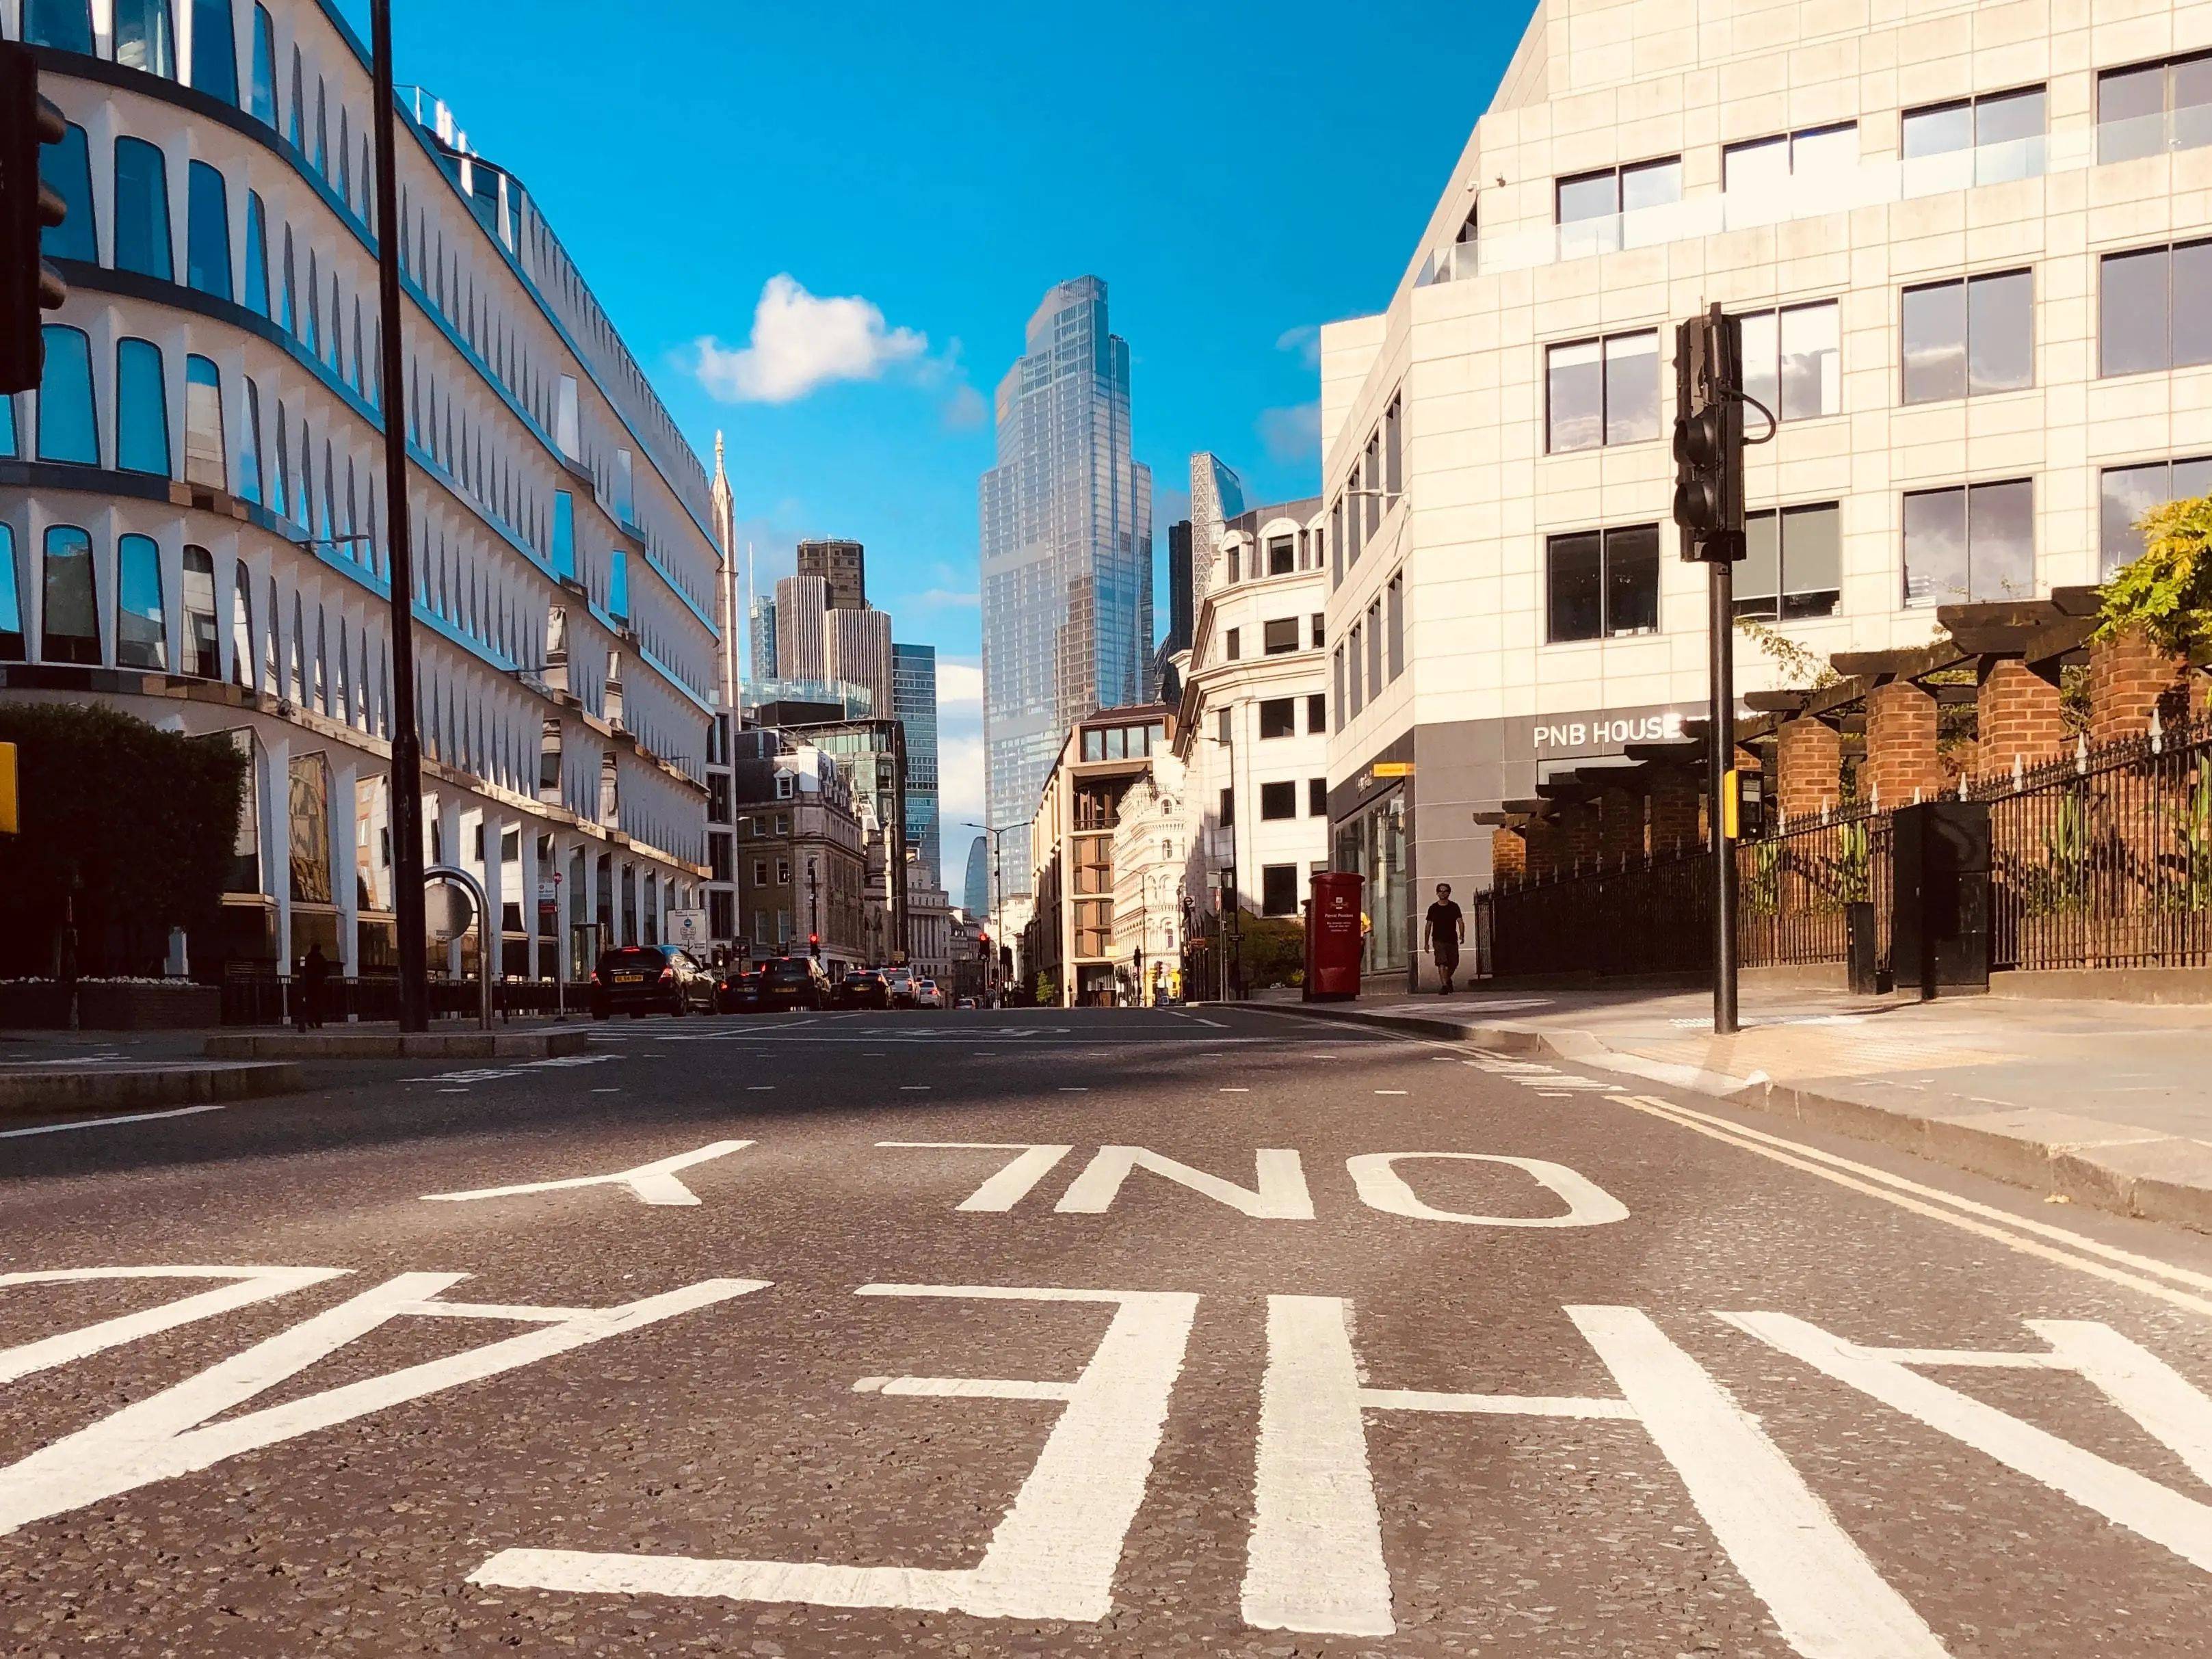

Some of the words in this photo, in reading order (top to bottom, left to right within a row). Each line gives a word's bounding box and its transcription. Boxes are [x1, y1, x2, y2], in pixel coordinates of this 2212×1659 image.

[1533, 723, 1585, 749] PNB
[1593, 714, 1682, 744] HOUSE
[418, 1140, 1630, 1227] ONLY
